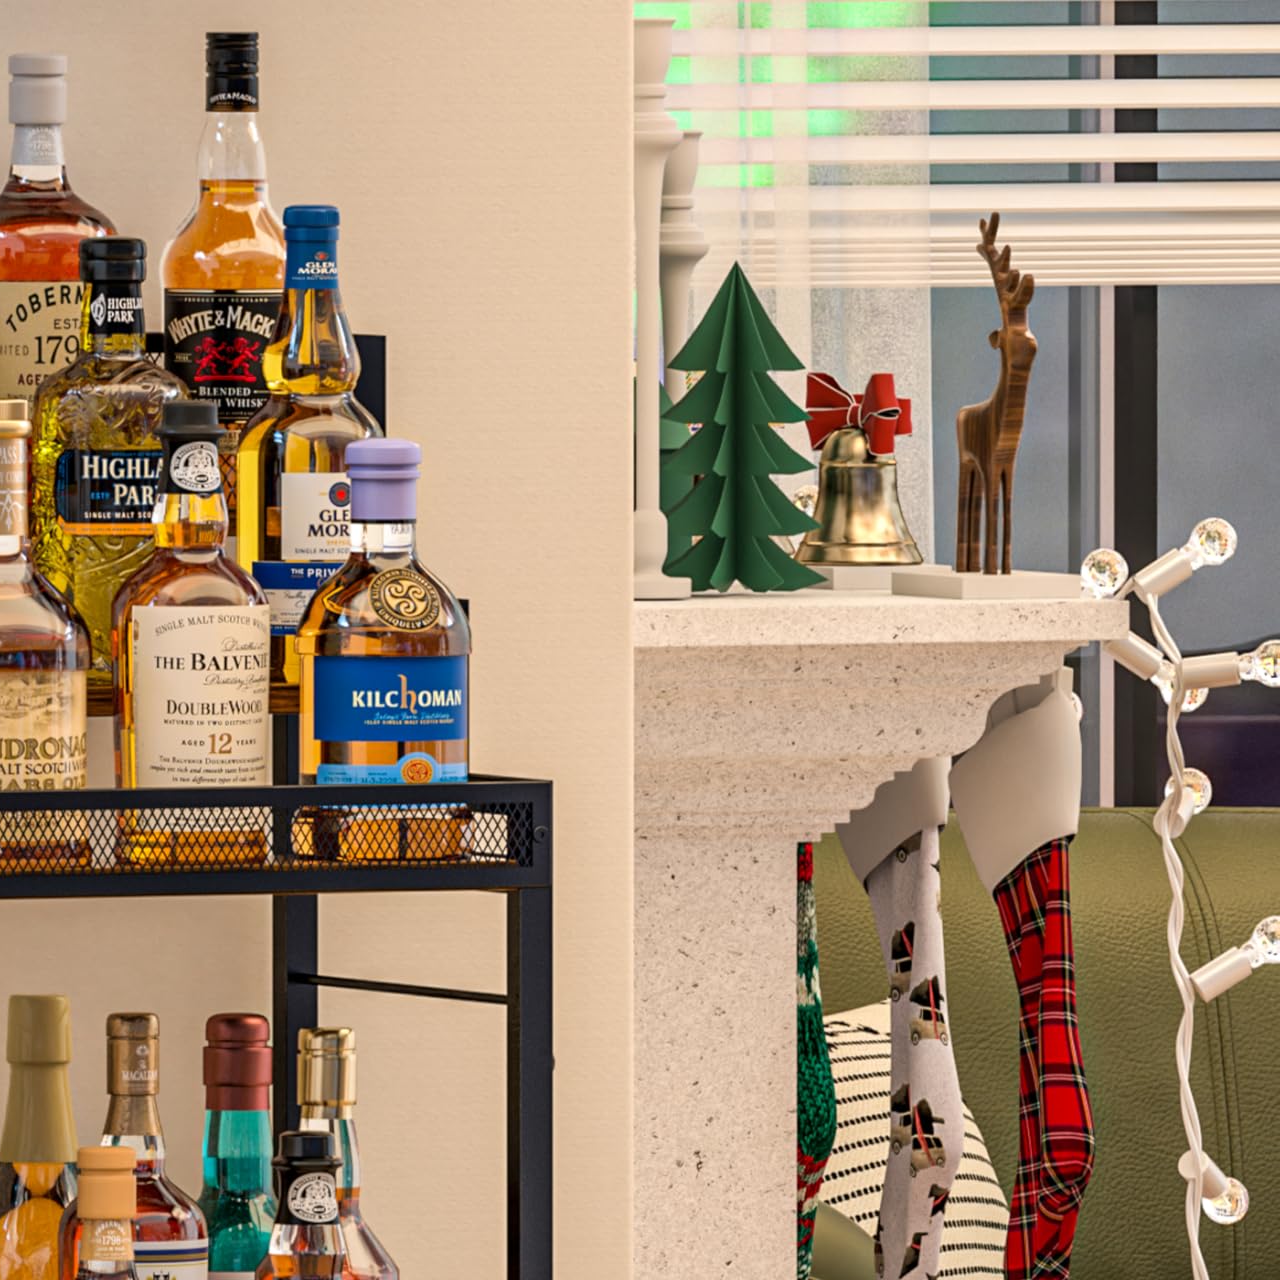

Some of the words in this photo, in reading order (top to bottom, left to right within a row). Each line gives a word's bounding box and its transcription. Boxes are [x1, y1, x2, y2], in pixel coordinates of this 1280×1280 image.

[107, 311, 134, 322] PARK
[168, 310, 216, 345] WHYTE
[199, 387, 251, 397] BLENDED
[113, 484, 159, 505] PAR
[290, 568, 304, 577] THE
[154, 619, 185, 637] SINGLE
[187, 614, 215, 626] MALT
[217, 615, 251, 626] SCOTCH
[154, 656, 185, 670] THE
[191, 653, 269, 671] BALVENIE
[208, 732, 233, 754] 12
[25, 761, 69, 775] SCOTCH
[63, 775, 86, 790] OLD
